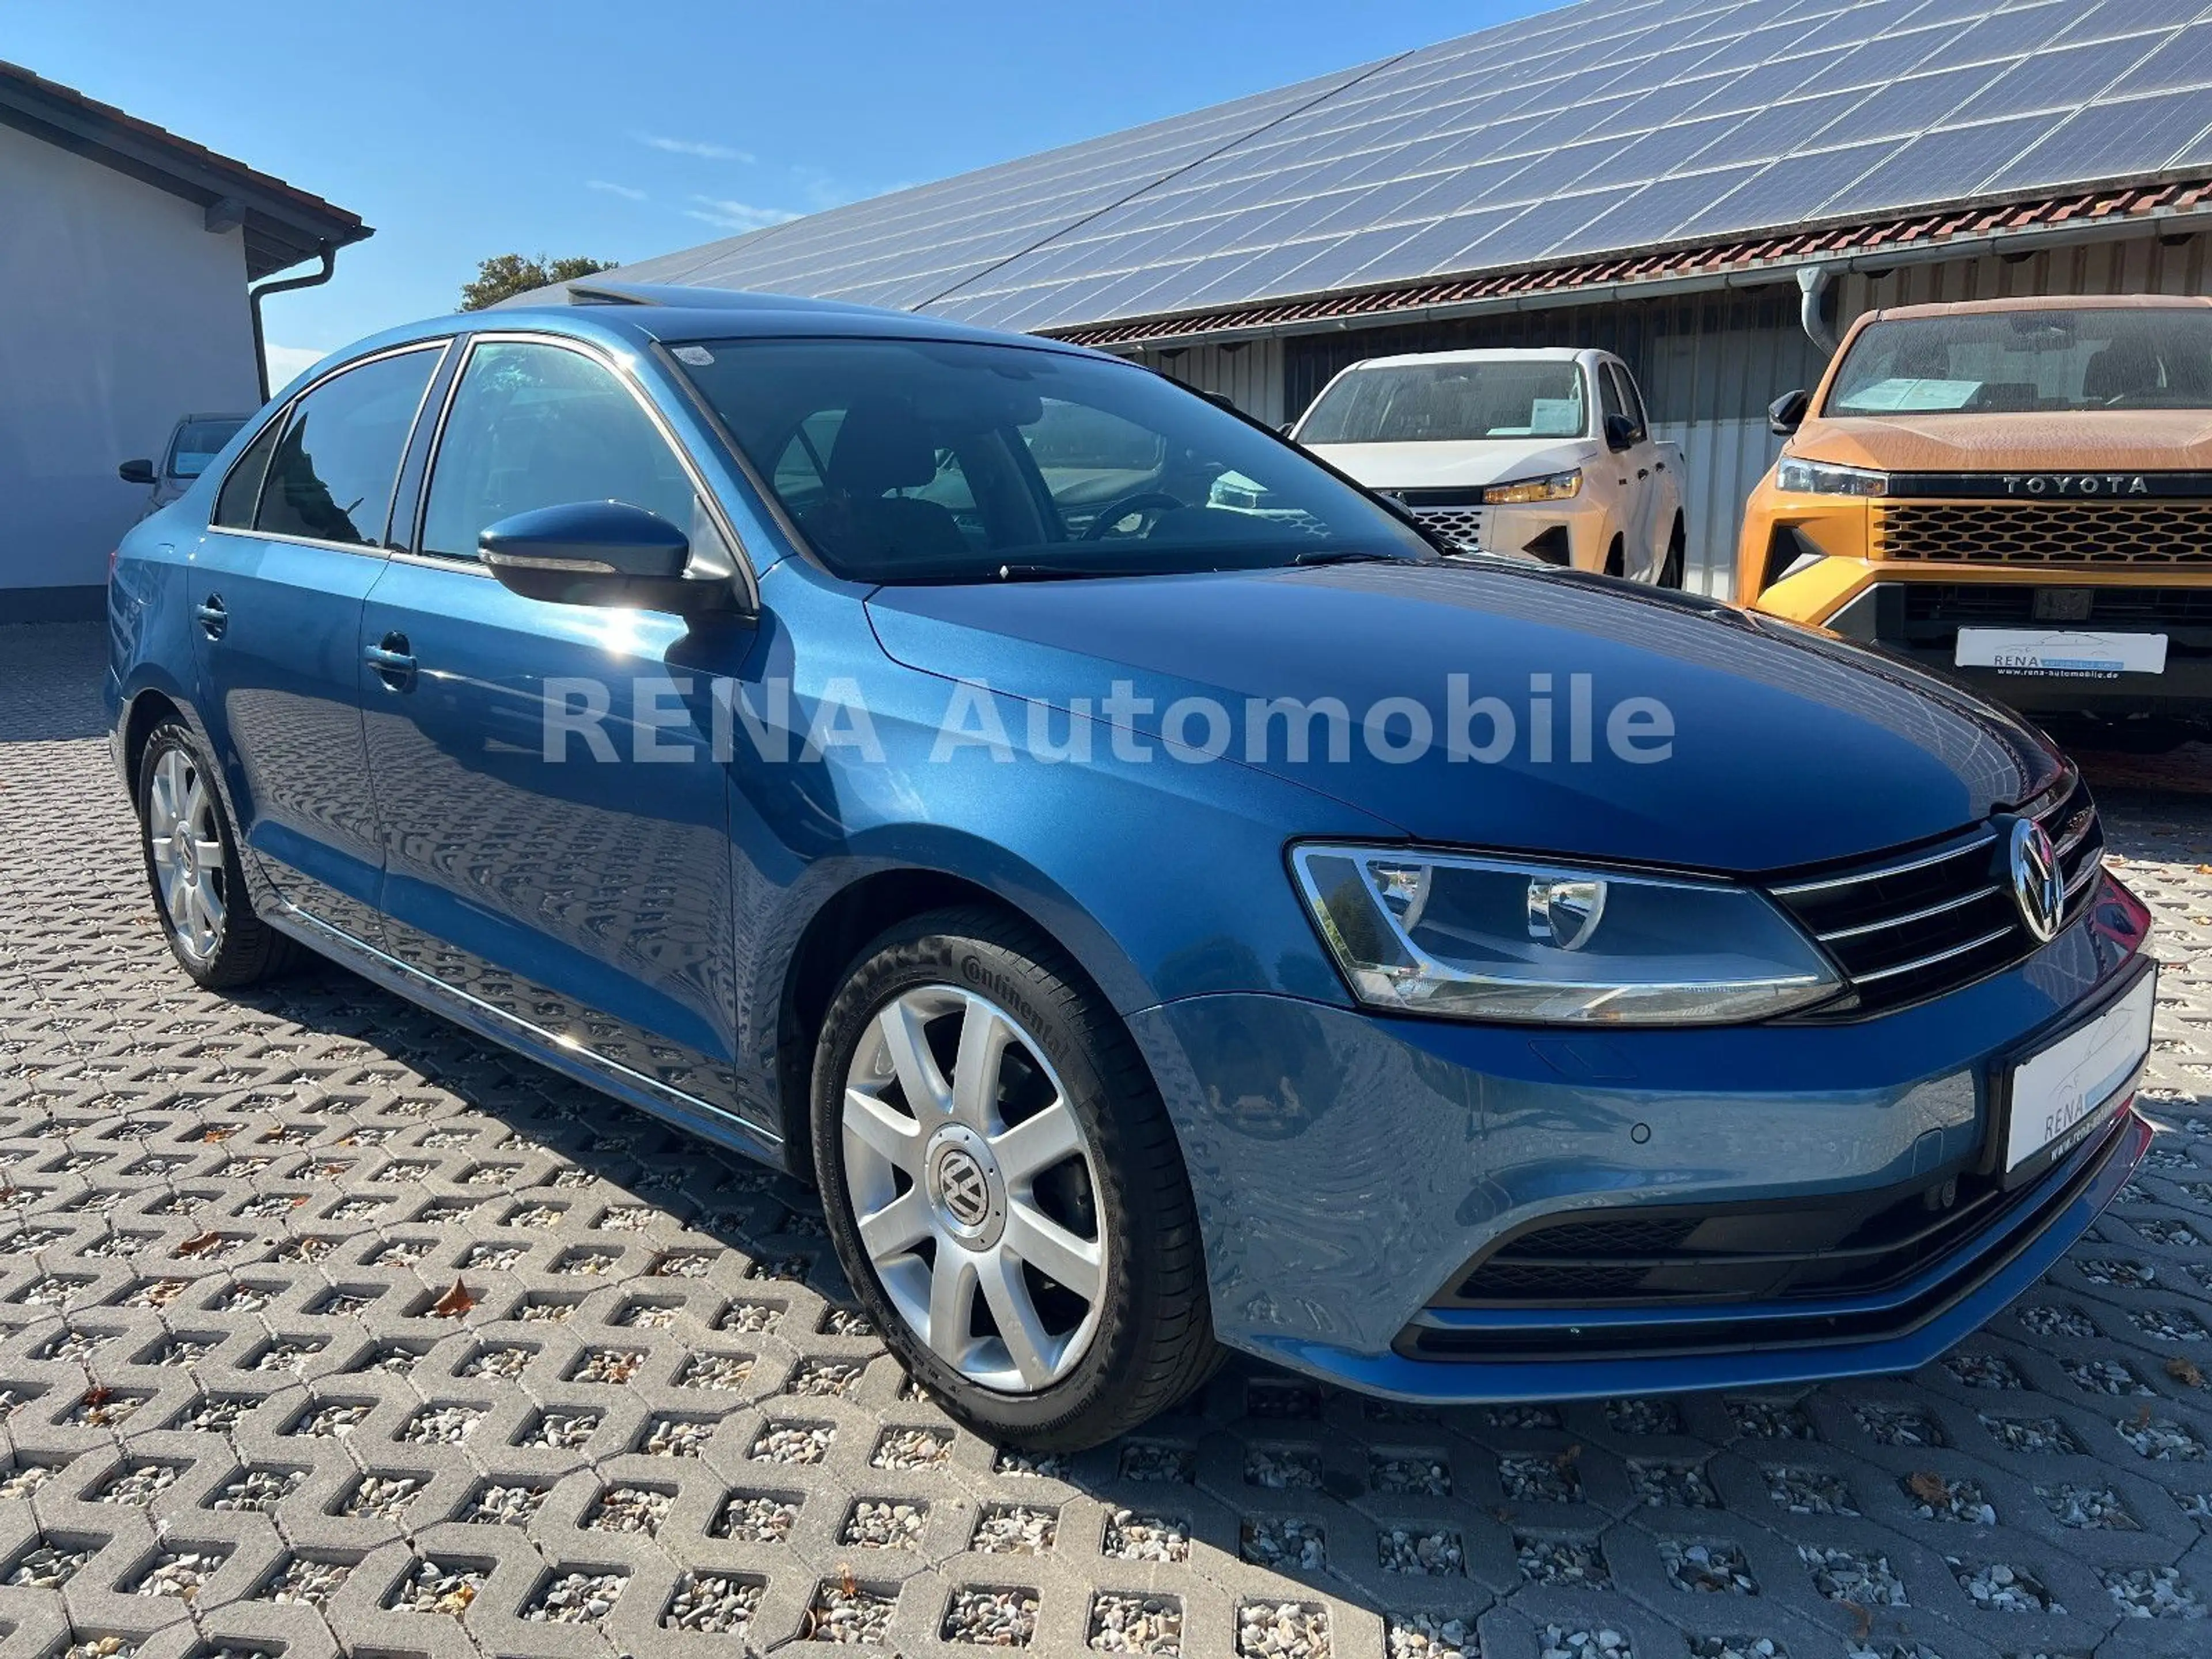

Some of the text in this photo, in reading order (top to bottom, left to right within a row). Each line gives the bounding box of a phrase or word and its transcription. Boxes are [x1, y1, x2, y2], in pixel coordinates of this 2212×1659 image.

[2003, 476, 2149, 494] TOYOTA
[1994, 655, 2039, 666] RENA
[1997, 668, 2119, 679] www.rena-automobile.de
[2045, 1093, 2084, 1142] RENA
